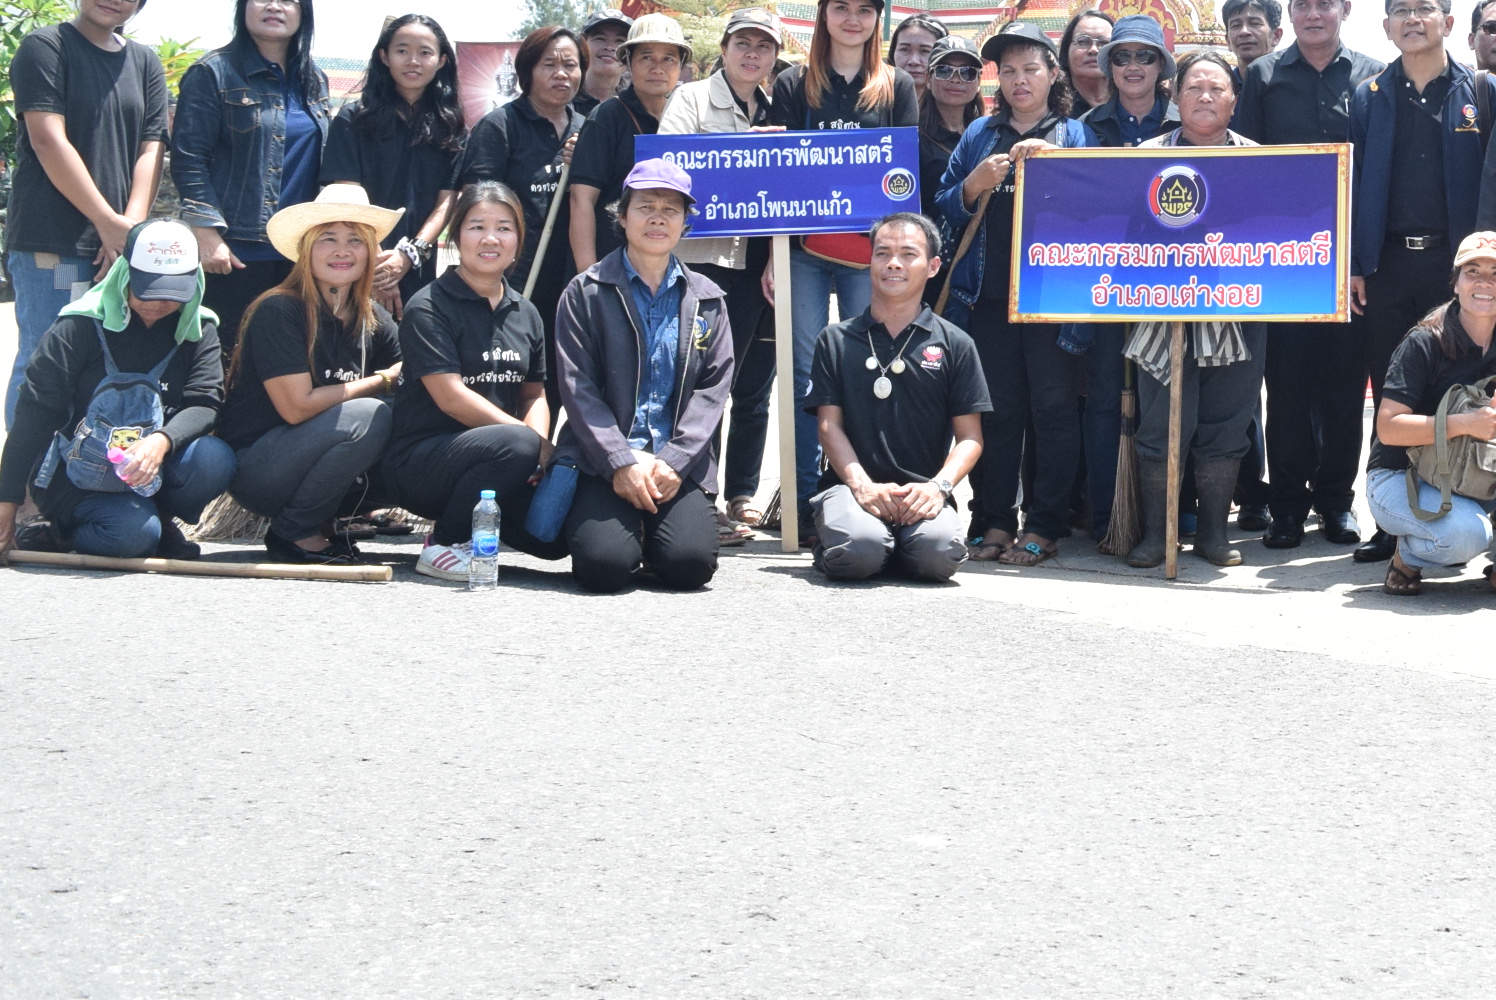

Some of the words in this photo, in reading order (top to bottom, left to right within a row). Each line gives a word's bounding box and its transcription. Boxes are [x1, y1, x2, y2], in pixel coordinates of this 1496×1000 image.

[661, 135, 893, 170] คณะกรรมการพัฒนาสตรี
[705, 190, 853, 221] อำเภอโพนนาแก้ว
[1028, 230, 1333, 268] คณะกรรมการพัฒนาสตรี
[1091, 274, 1263, 307] อำเภอเต่างอย
